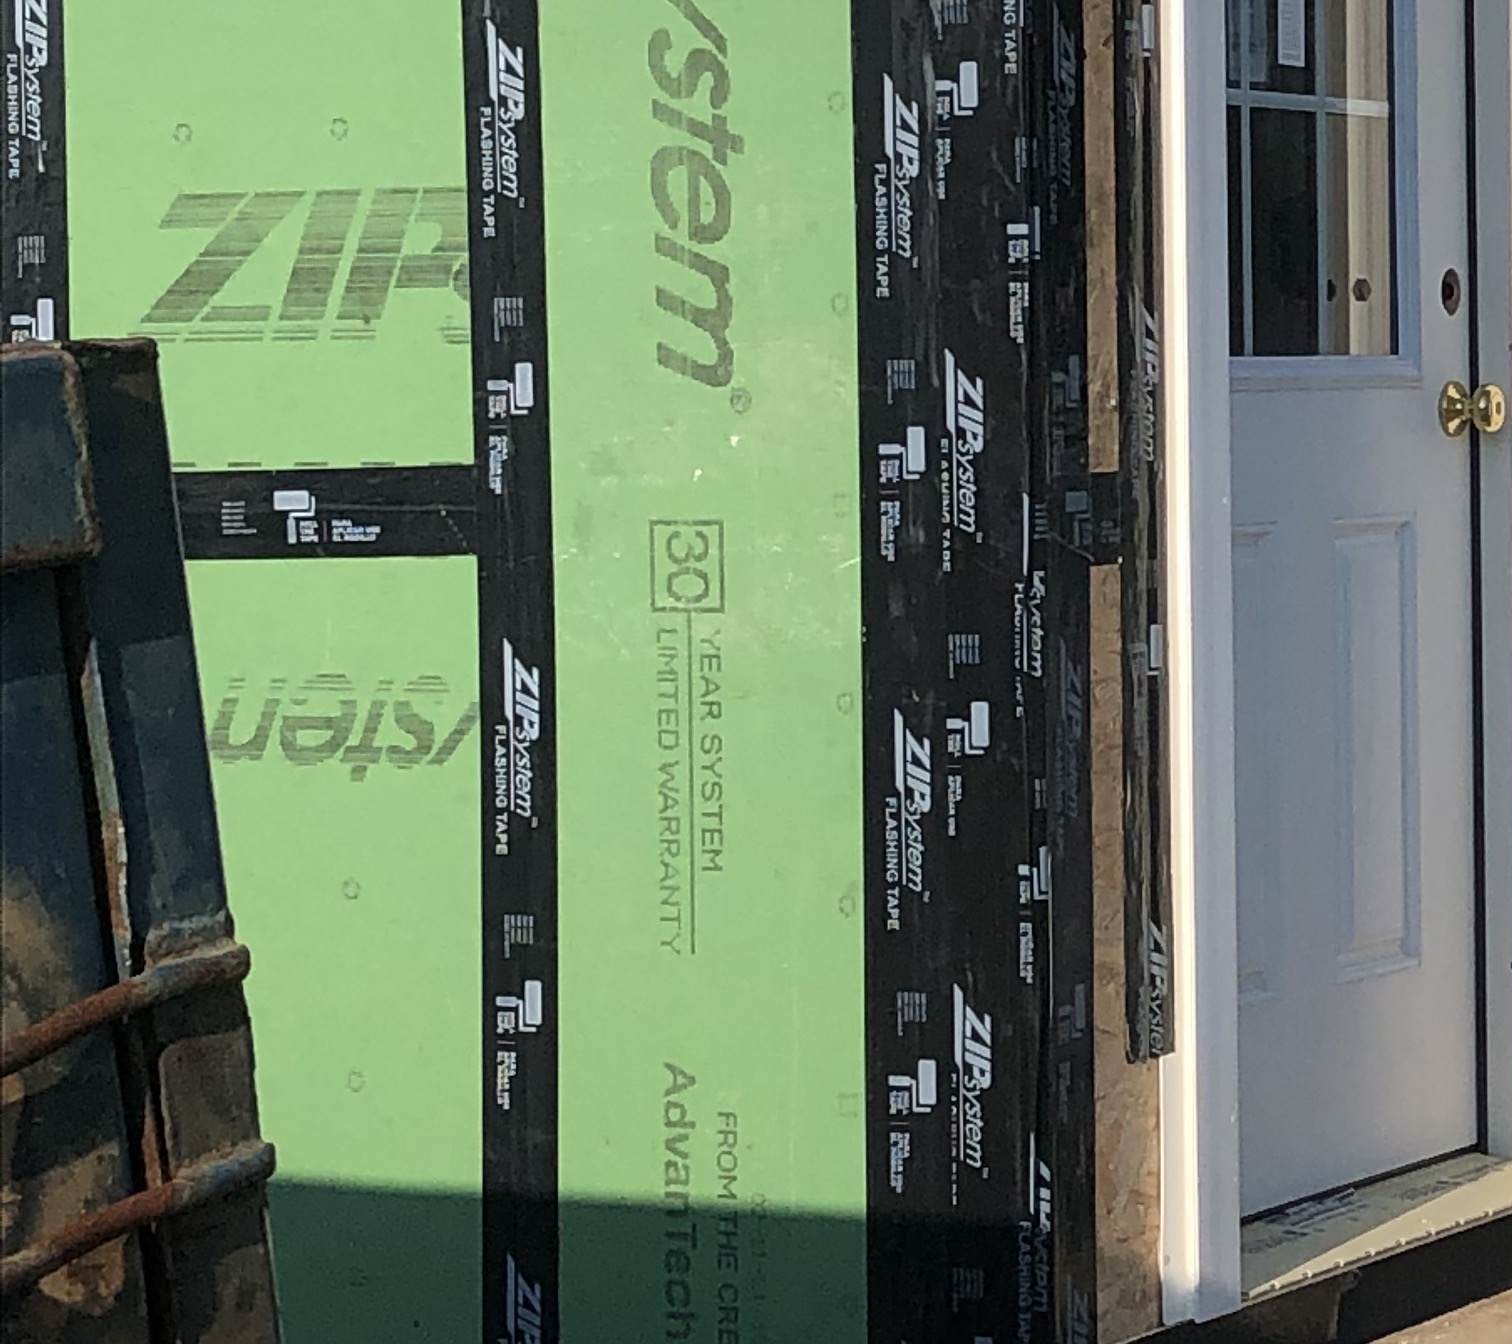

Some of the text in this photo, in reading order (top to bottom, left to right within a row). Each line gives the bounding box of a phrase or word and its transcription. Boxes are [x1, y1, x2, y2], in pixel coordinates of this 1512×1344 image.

[6, 52, 21, 180] FLASHING TAPE
[1003, 28, 1018, 76] TAPE
[479, 105, 496, 239] FLASHING TAPE
[874, 162, 890, 299] FLASHING TAPE
[664, 530, 711, 605] 30
[491, 725, 509, 856] FLASHING TAPE
[654, 627, 683, 956] LIMITED WARRANTY
[698, 628, 725, 874] YEAR SYSTEM
[885, 796, 901, 931] FLASHING TAPE
[717, 1111, 739, 1202] FROM
[718, 1207, 739, 1275] THE
